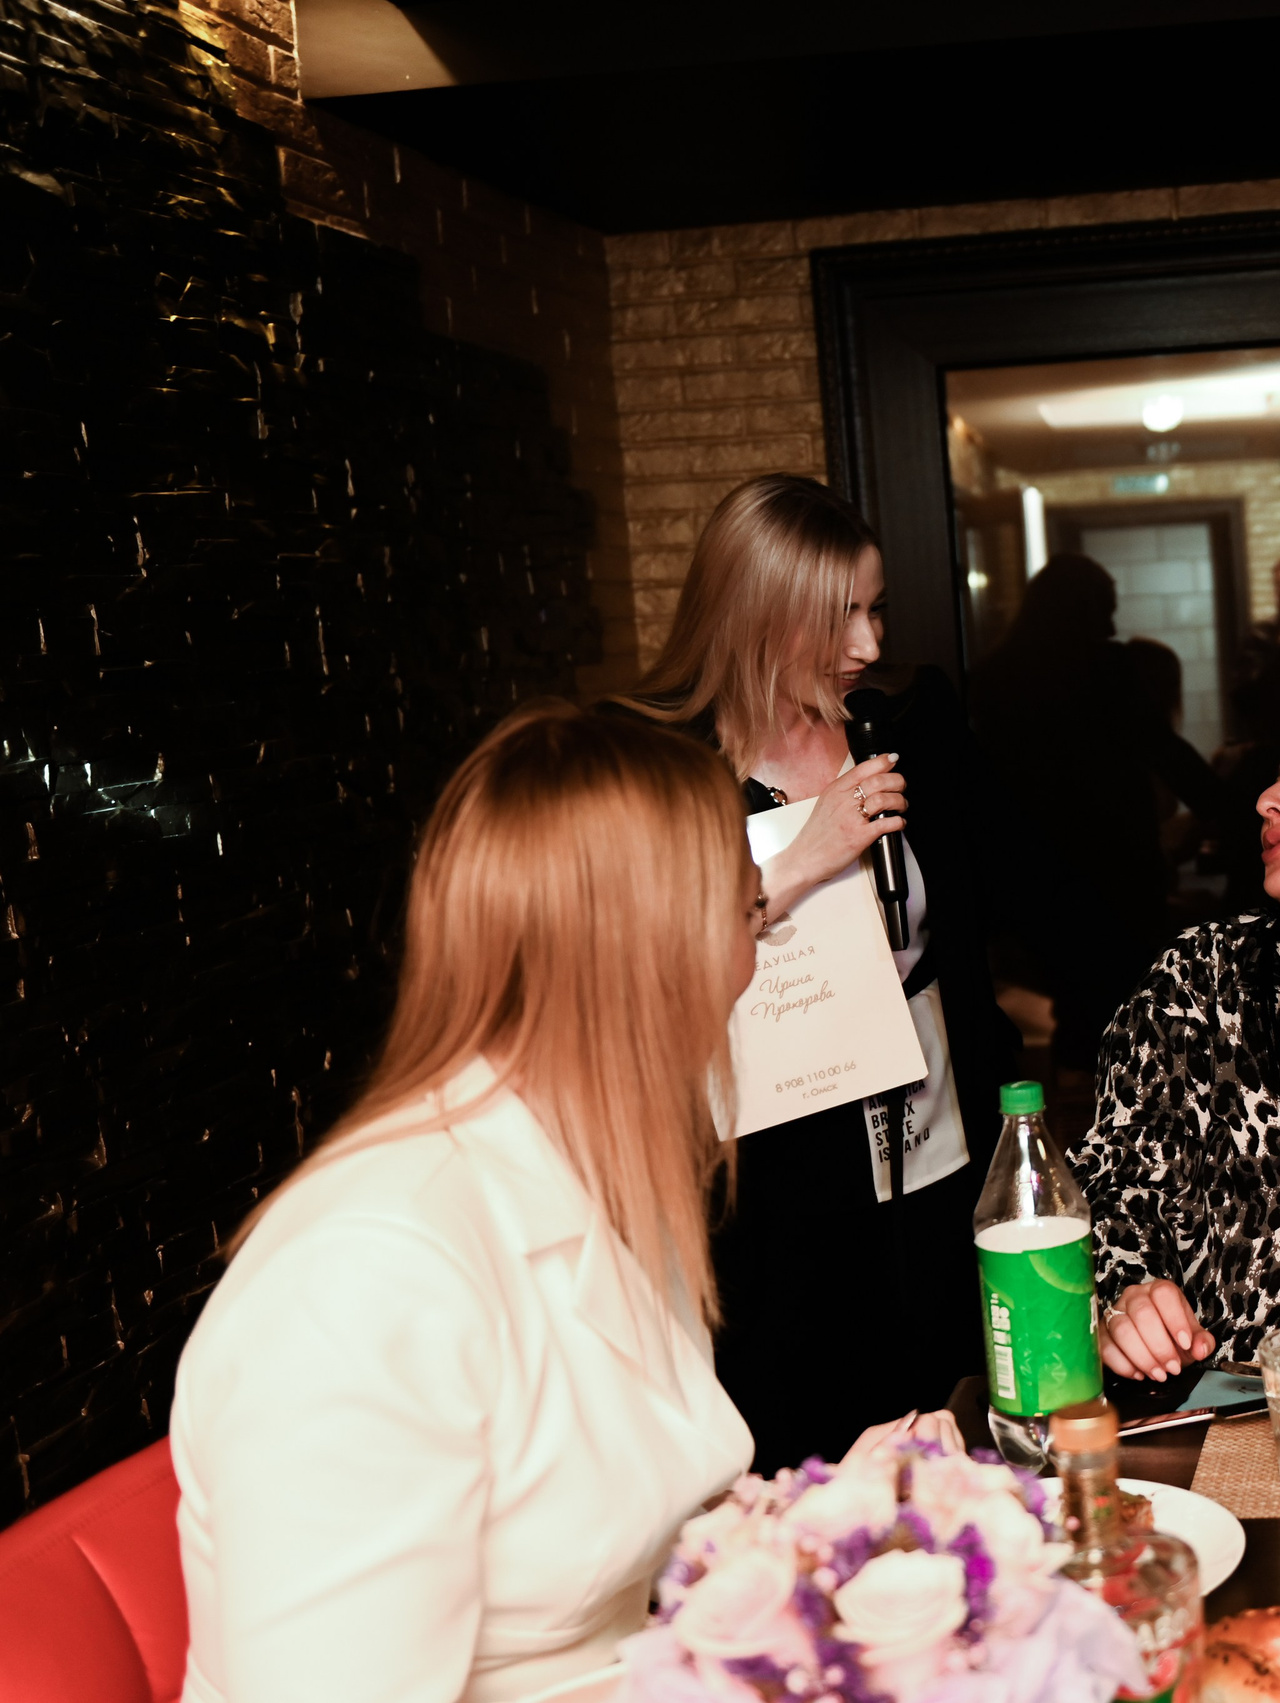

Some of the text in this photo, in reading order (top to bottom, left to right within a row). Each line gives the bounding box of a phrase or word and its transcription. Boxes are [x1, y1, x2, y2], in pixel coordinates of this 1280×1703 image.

[755, 945, 815, 972] ЕДУЩАЯ
[759, 974, 815, 999] Ирина
[775, 1060, 857, 1093] 8 908 110 00 66
[871, 1100, 916, 1130] BRX
[875, 1120, 915, 1147] STE
[878, 1127, 931, 1163] ISAND
